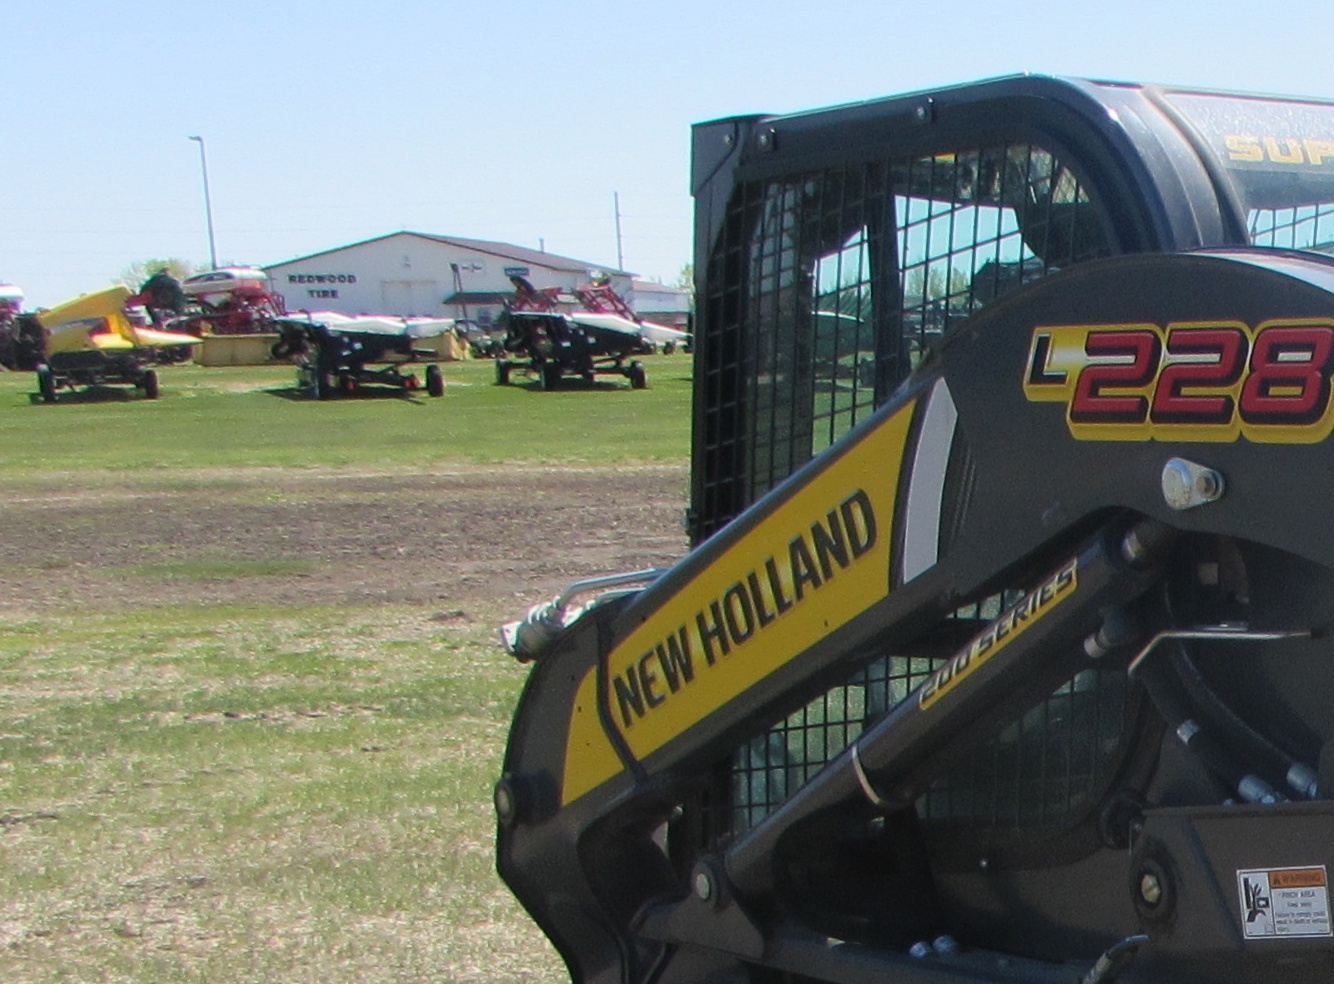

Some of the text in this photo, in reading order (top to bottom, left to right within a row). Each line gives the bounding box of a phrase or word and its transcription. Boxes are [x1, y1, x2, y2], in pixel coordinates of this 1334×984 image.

[287, 274, 357, 284] REDWOOD
[307, 289, 339, 299] TIRE
[612, 487, 878, 729] NEW HOLLAND
[970, 564, 1076, 662] SERIES
